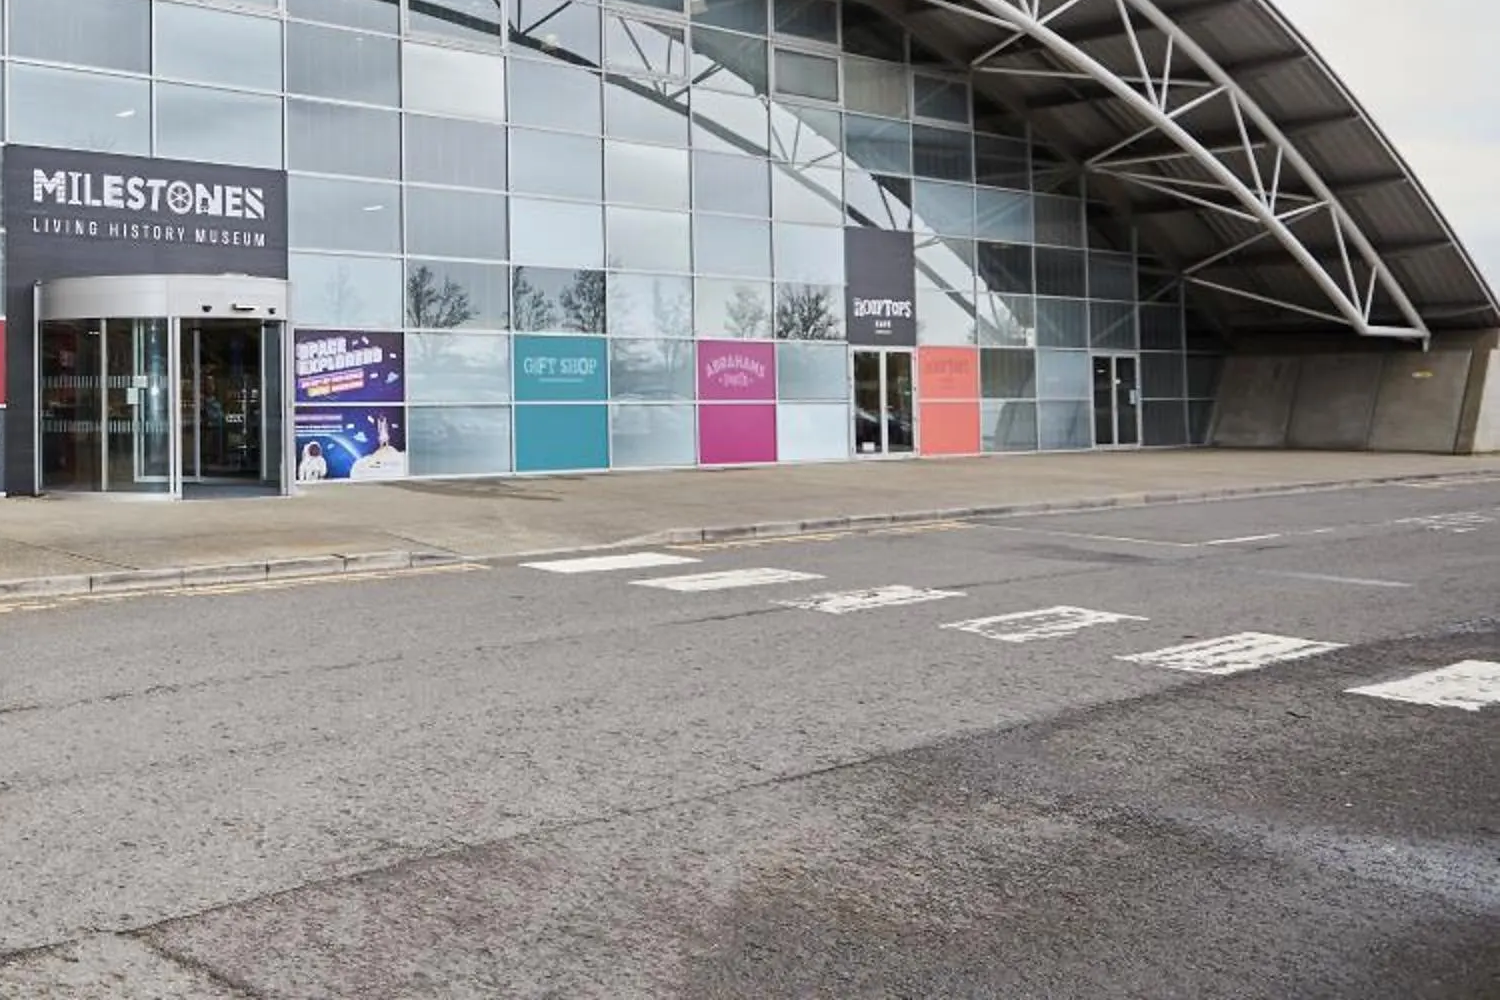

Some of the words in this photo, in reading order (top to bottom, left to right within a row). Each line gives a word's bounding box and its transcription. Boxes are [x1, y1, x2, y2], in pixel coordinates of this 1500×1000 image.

[33, 168, 266, 220] MILESTONES
[33, 217, 99, 236] LIVING
[109, 223, 186, 242] HISTORY
[195, 228, 267, 248] MUSEUM
[523, 356, 557, 375] GIFT
[560, 357, 597, 375] SHOP
